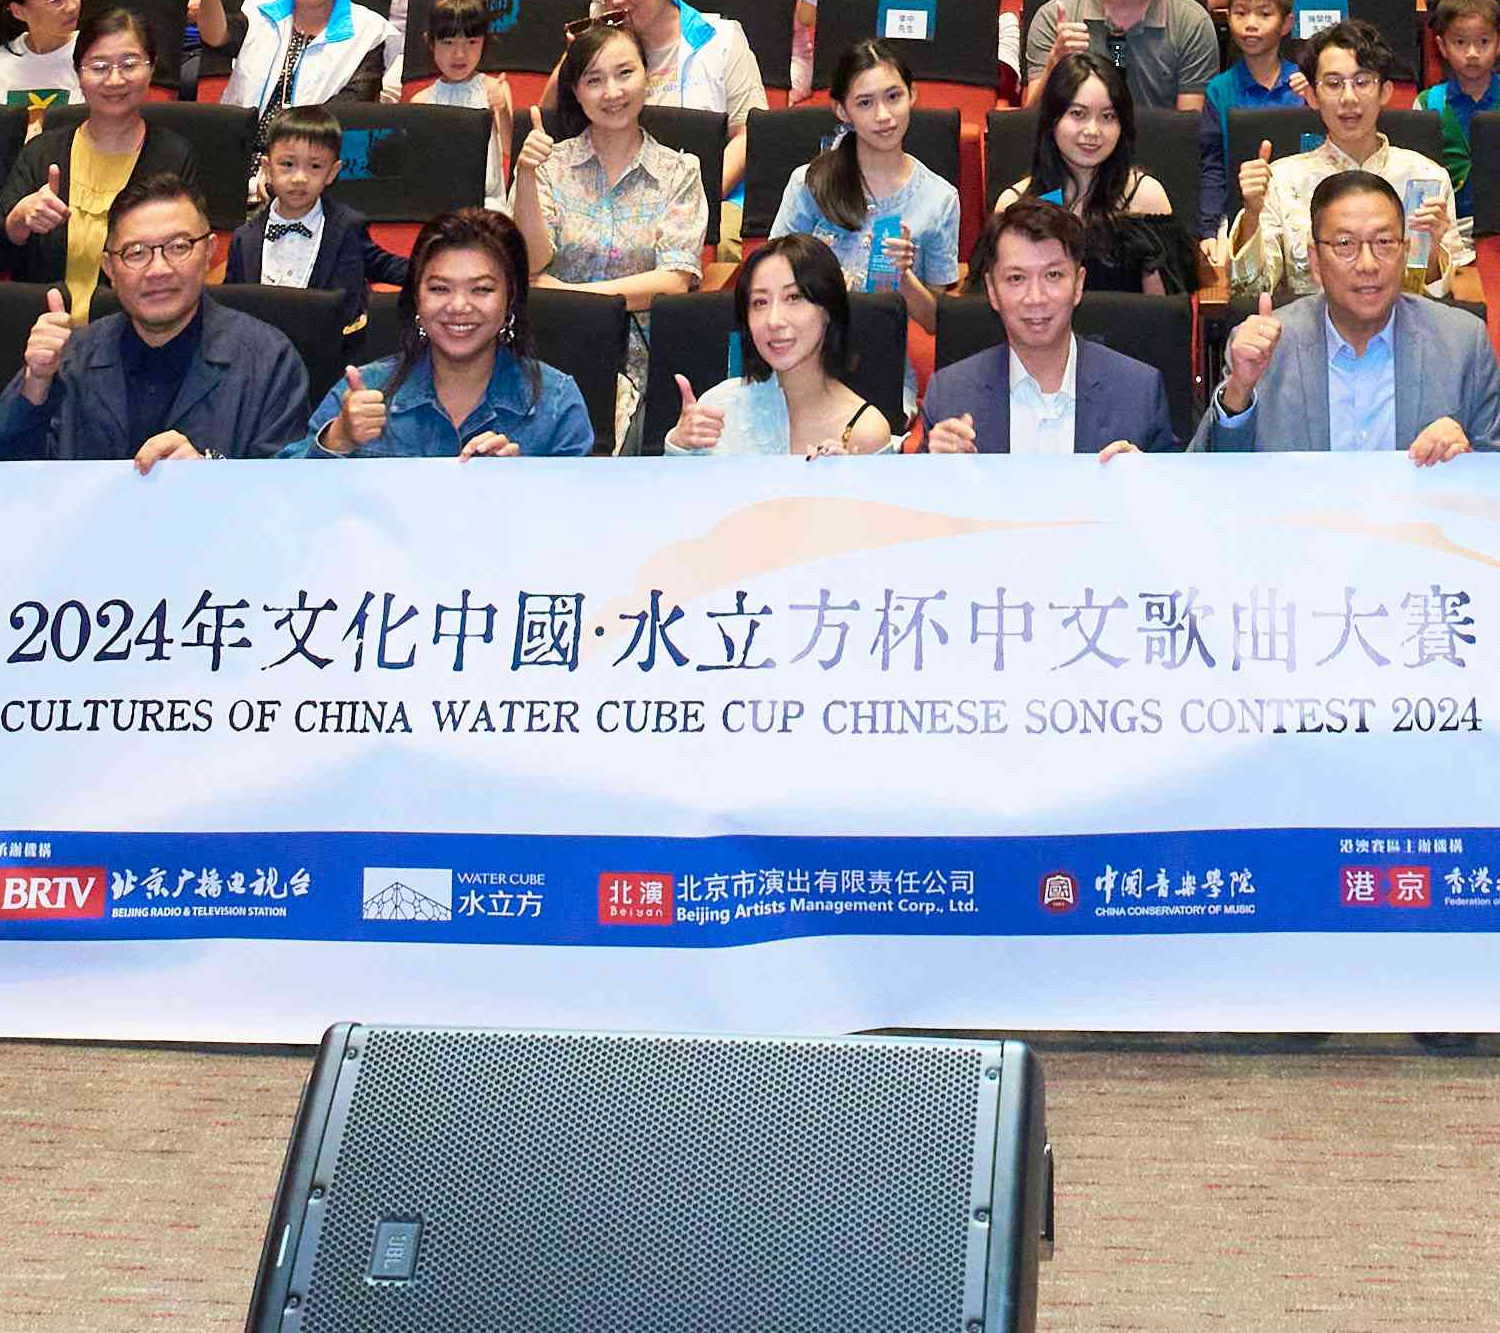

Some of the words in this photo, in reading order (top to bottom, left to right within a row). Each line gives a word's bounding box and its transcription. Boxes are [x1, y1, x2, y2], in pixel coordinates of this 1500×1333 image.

[4, 585, 1476, 673] 2024年文化中國·水立方杯中文歌曲大賽
[0, 699, 212, 734] CULTURES
[229, 699, 282, 733] OF
[294, 700, 412, 734] CHINA
[432, 700, 580, 734] WATER
[596, 700, 705, 734] CUBE
[722, 700, 805, 734] CUP
[823, 700, 1008, 734] CHINESE
[1026, 699, 1163, 734] SONGS
[1180, 698, 1377, 734] CONTEST
[1392, 697, 1483, 732] 2024
[111, 868, 311, 900] 北京广播电视台
[457, 873, 507, 885] WATER
[509, 873, 545, 885] CUBE
[677, 869, 975, 903] 北京市演出有限责任公司
[2, 877, 96, 909] BRTV
[458, 890, 543, 918] 水立方
[609, 880, 663, 906] 北演
[1444, 896, 1491, 906] Federation
[112, 908, 149, 918] BEIJING
[150, 907, 181, 918] RADIO
[183, 907, 191, 917] &
[192, 907, 246, 917] TELEVISION
[248, 907, 286, 917] STATION
[609, 906, 663, 918] Beiyan
[677, 907, 730, 925] Beijing
[734, 901, 786, 919] Artists
[790, 898, 894, 914] Management
[949, 898, 979, 913] Ltd.
[1095, 907, 1126, 917] CHINA
[1127, 906, 1206, 916] CONSERVATORY
[1208, 905, 1221, 915] OF
[1224, 904, 1255, 914] MUSIC
